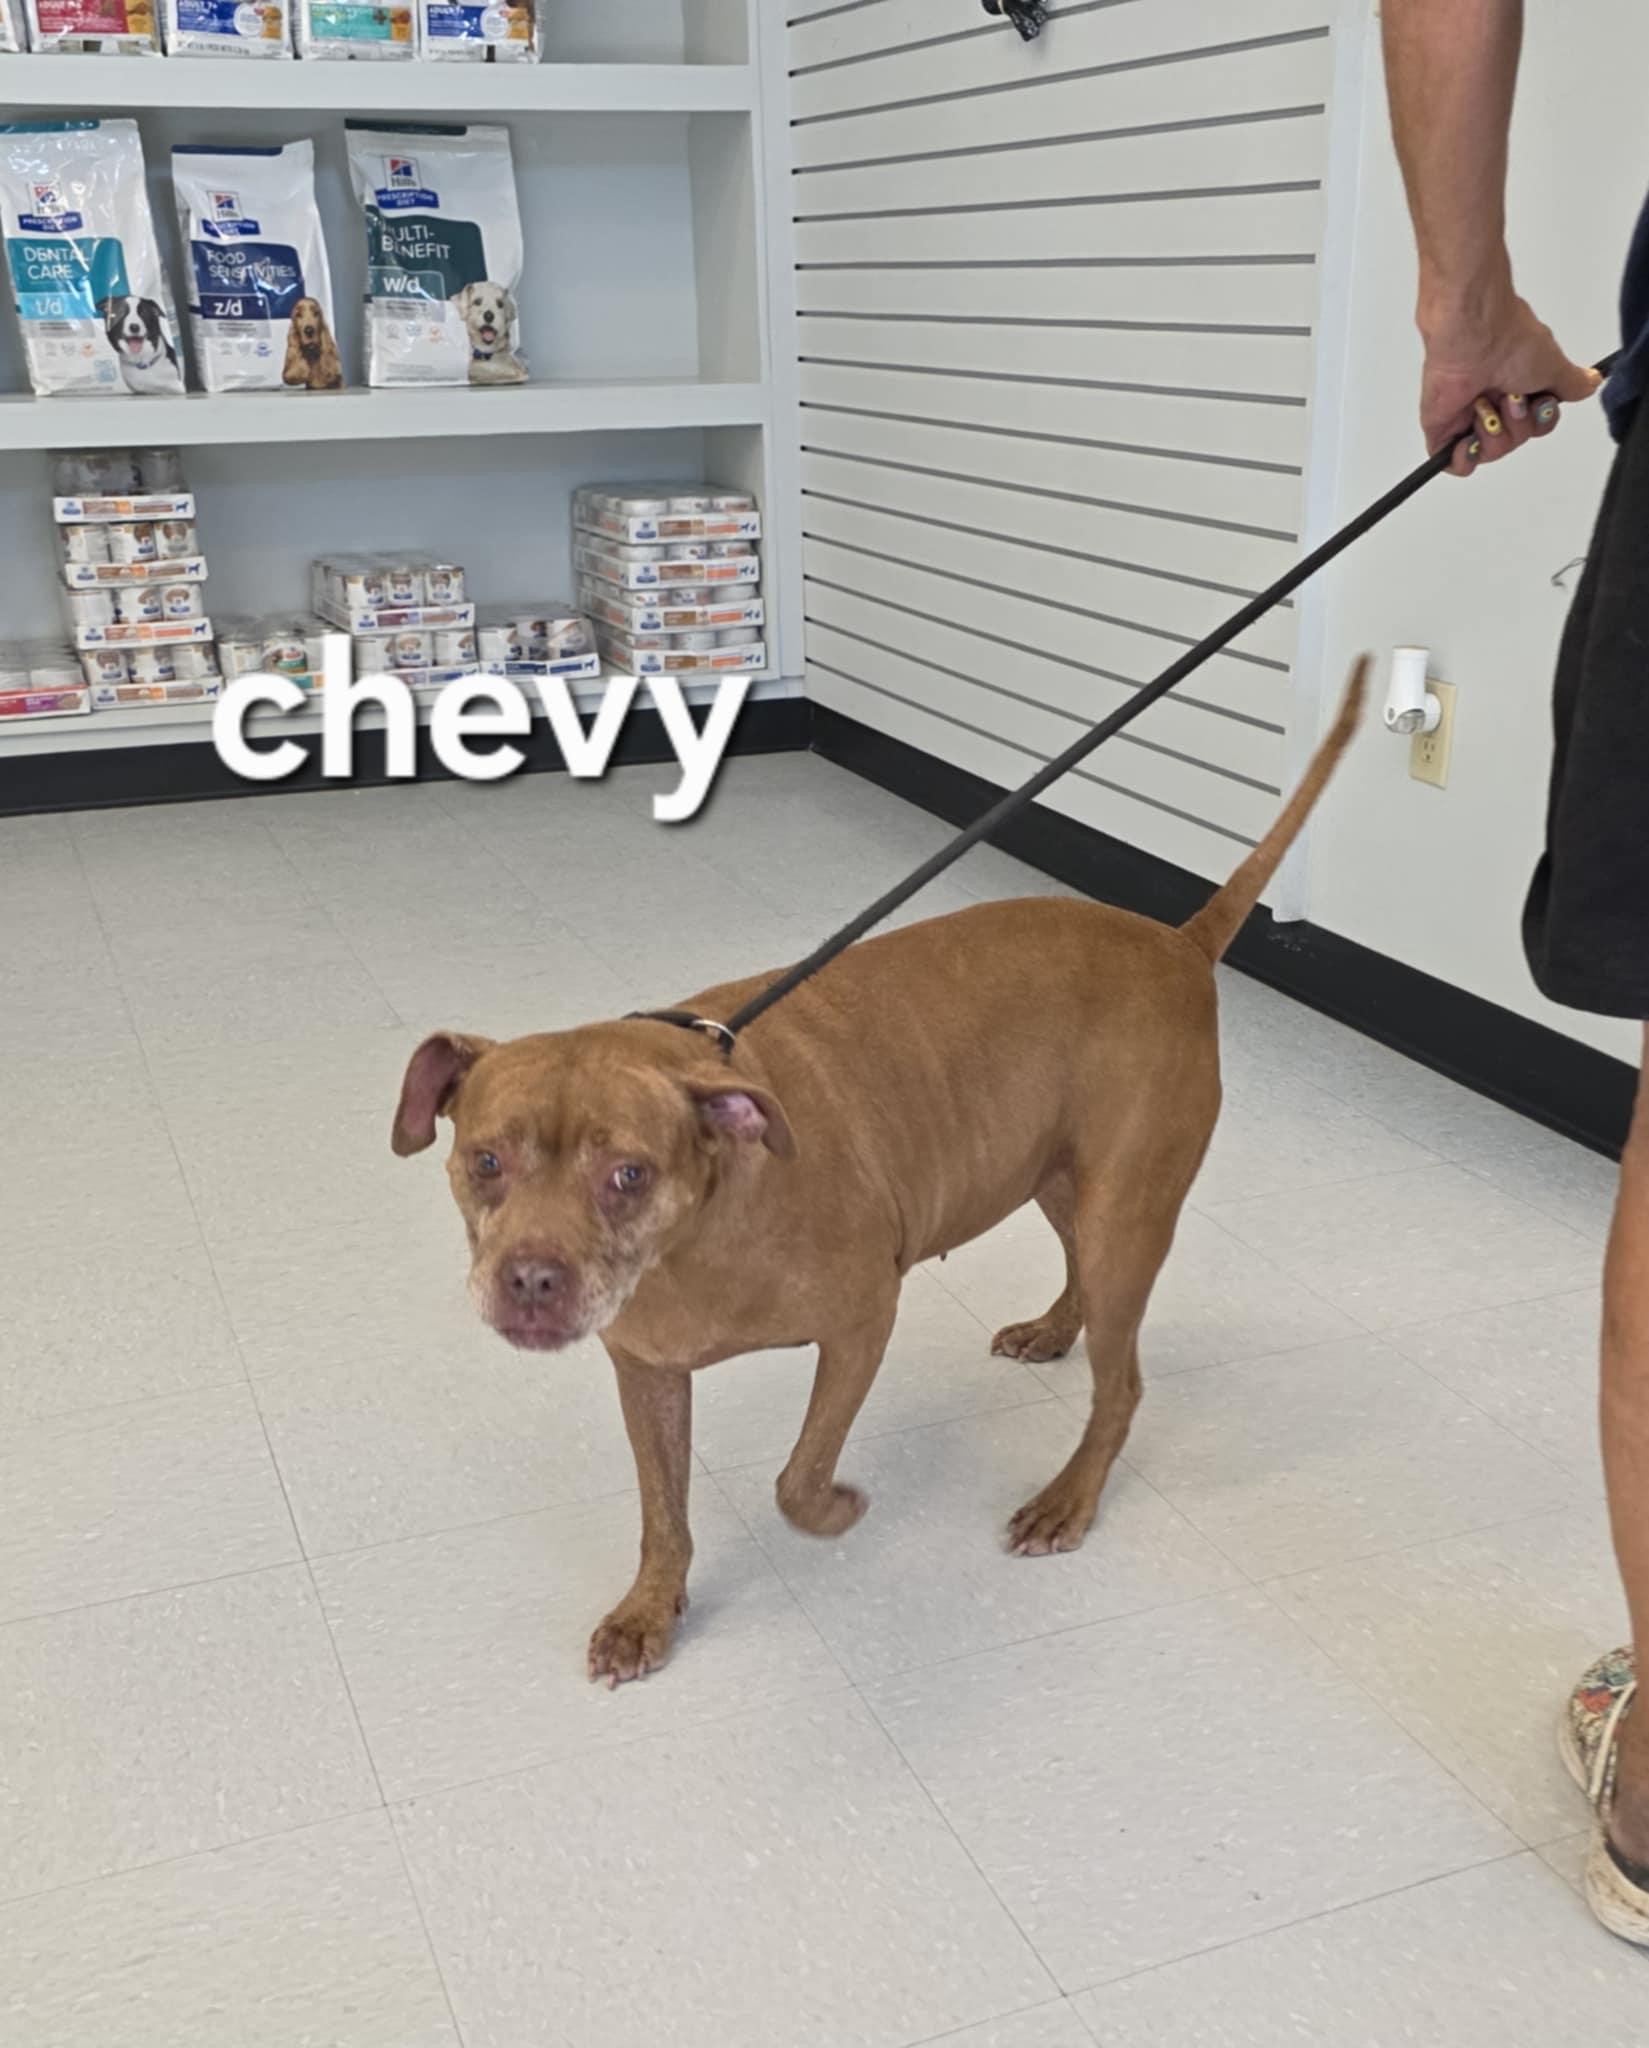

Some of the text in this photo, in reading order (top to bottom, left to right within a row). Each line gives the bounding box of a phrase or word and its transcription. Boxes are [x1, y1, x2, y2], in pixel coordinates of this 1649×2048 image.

[377, 191, 435, 201] PRESCRIPTION
[22, 216, 79, 225] PRESCRION
[23, 246, 91, 263] DENTAL
[207, 249, 247, 265] FOOD
[27, 264, 74, 280] CARE
[382, 275, 421, 294] w/d
[35, 299, 63, 316] t/d
[213, 298, 244, 317] z/d
